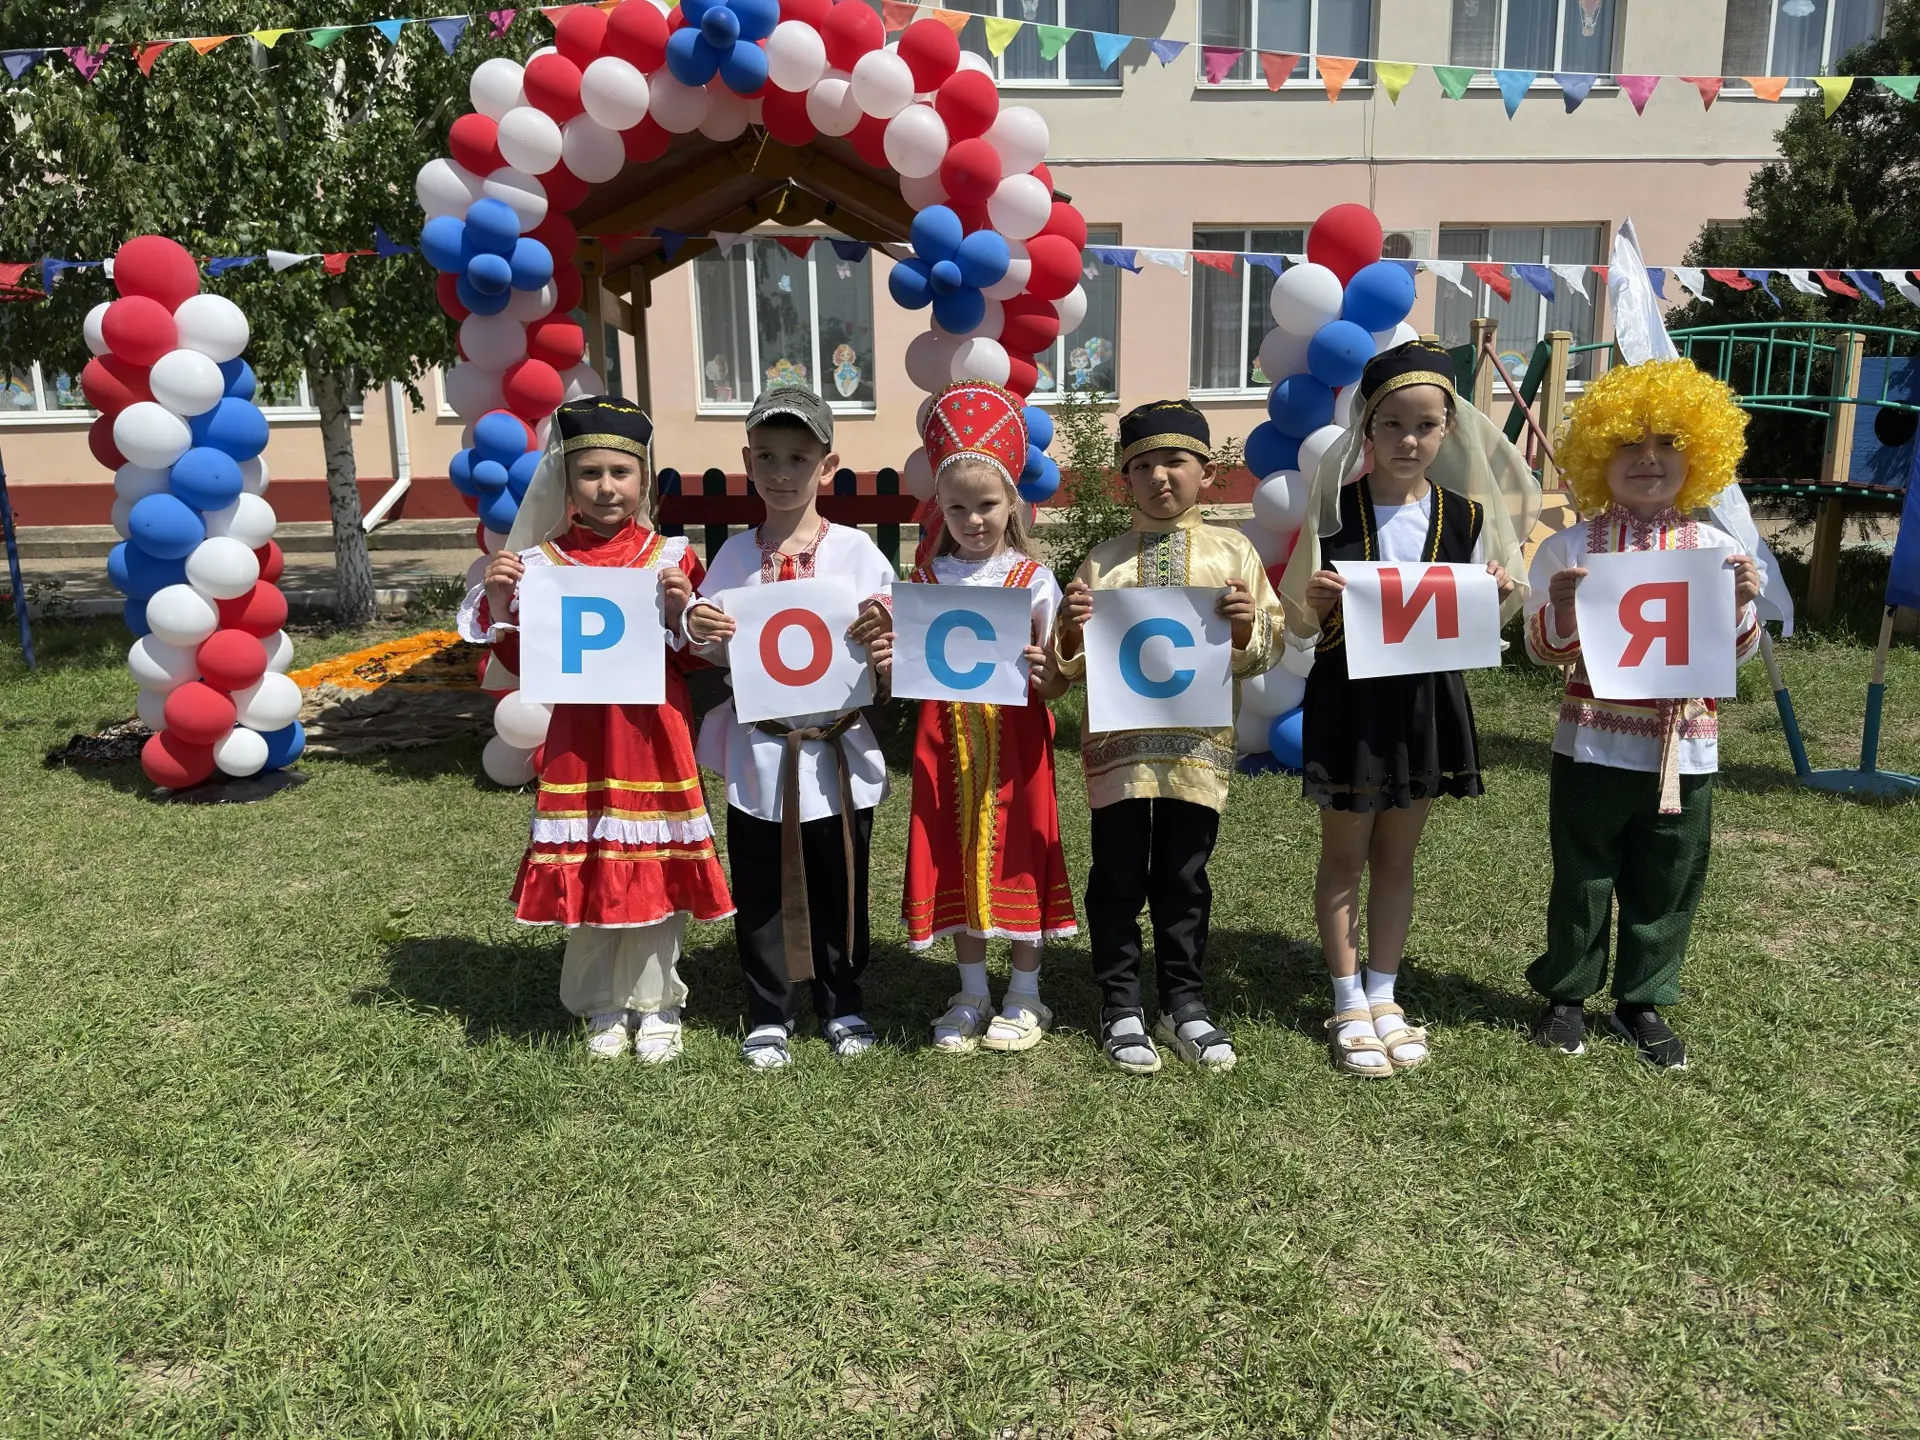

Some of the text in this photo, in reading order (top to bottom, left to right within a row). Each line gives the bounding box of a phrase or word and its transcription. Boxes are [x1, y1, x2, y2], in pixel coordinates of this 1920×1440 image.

[562, 596, 625, 674] Р
[1377, 566, 1459, 644] И
[1618, 581, 1689, 667] Я
[759, 608, 833, 687] О
[925, 609, 997, 690] С
[1118, 617, 1196, 699] С
